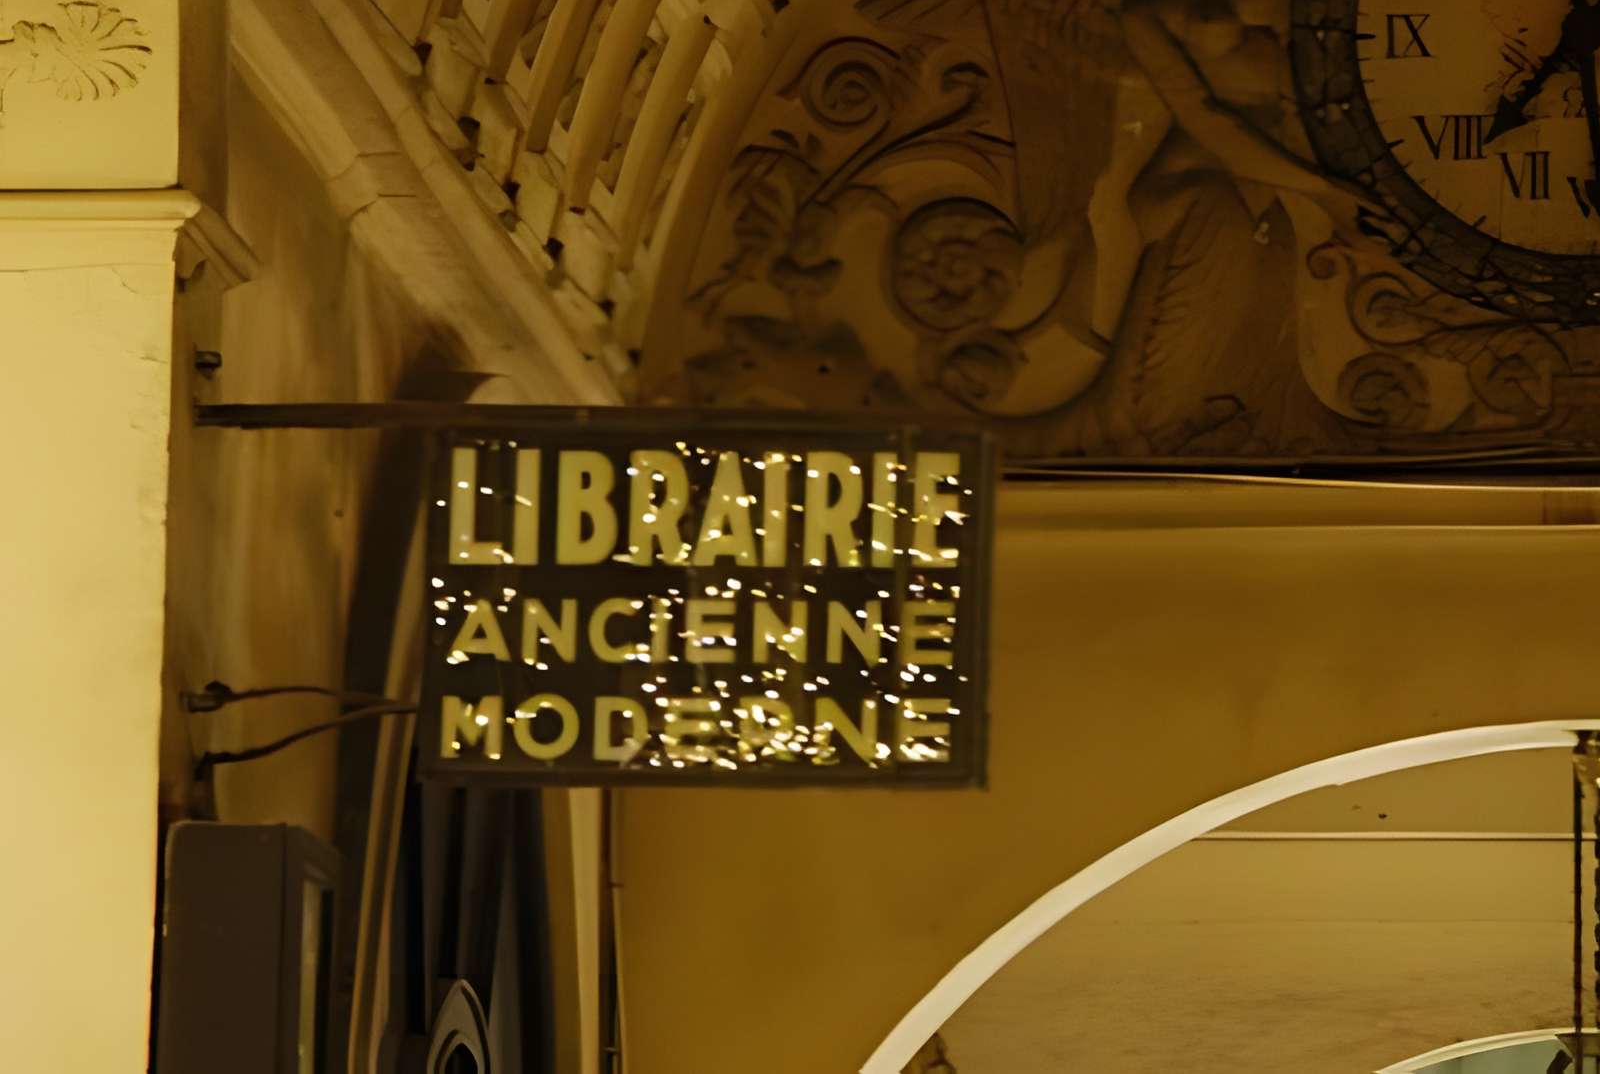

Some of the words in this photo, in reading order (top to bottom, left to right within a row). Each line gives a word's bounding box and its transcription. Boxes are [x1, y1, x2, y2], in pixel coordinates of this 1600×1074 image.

[1385, 14, 1431, 59] IX
[1411, 115, 1487, 160] VIII
[1500, 151, 1551, 200] VII
[449, 446, 962, 568] LIBRAIRIE
[449, 597, 956, 666] ANCIENNE
[440, 693, 952, 764] MODERNE
